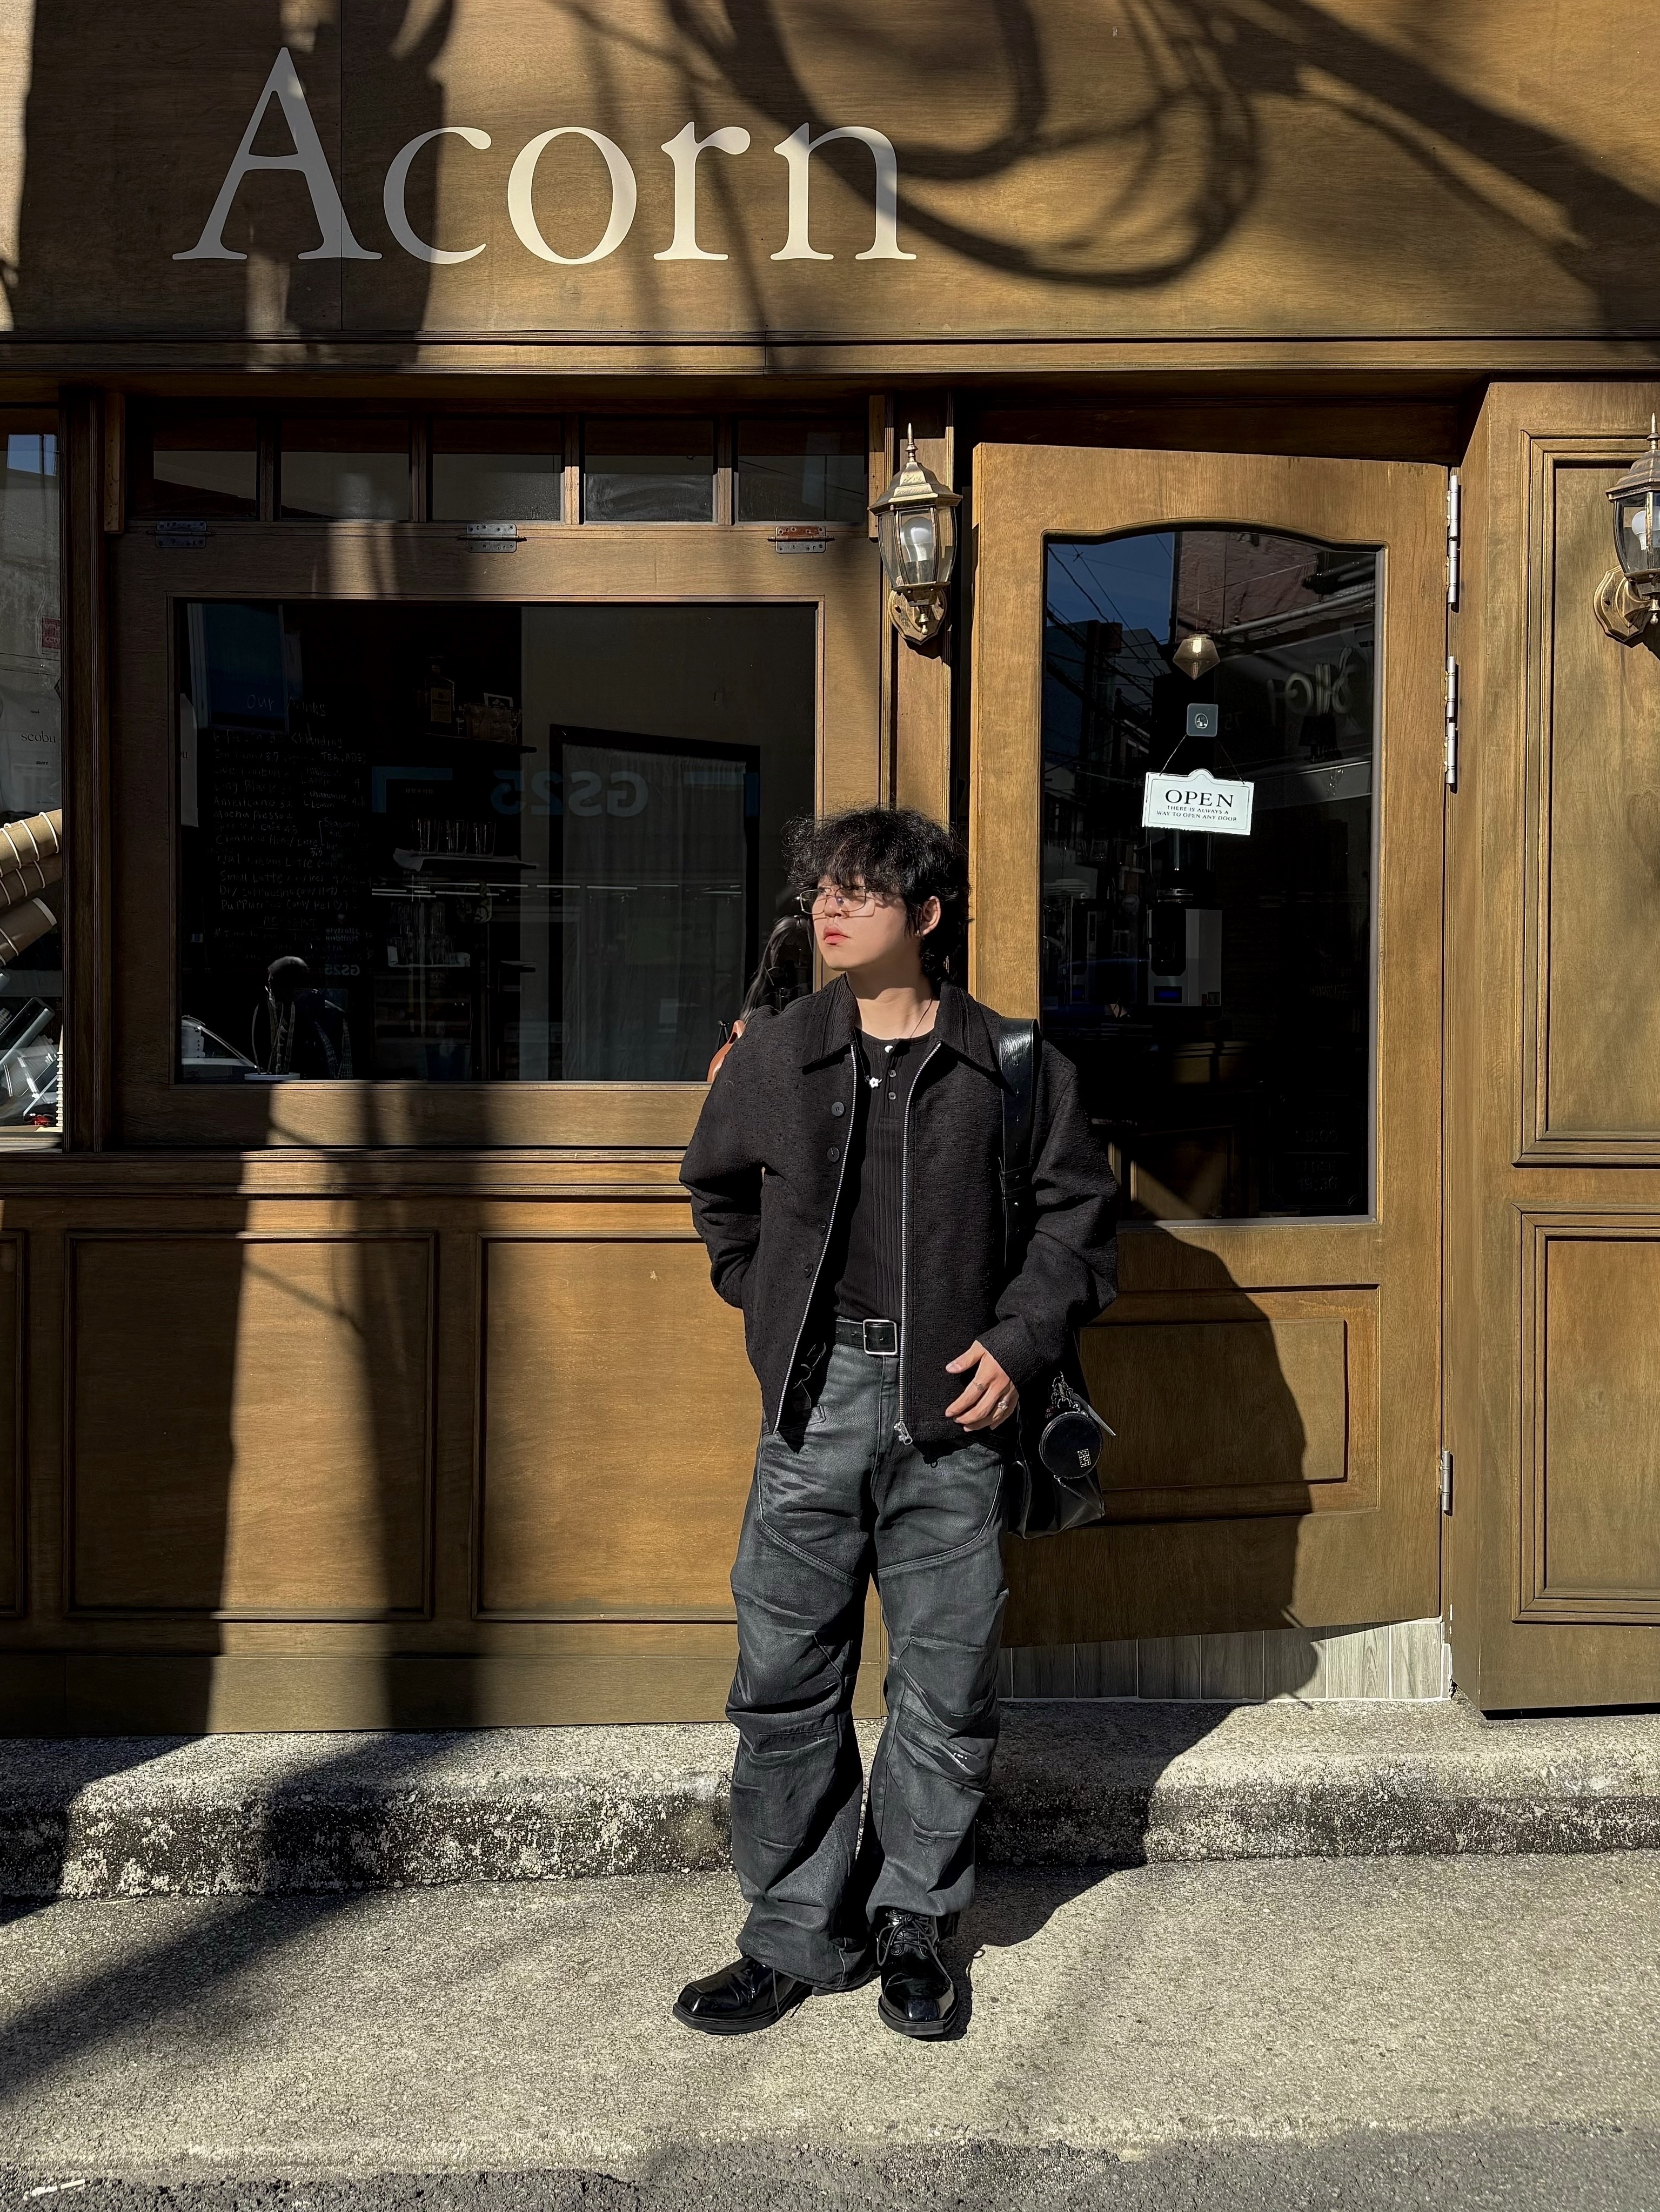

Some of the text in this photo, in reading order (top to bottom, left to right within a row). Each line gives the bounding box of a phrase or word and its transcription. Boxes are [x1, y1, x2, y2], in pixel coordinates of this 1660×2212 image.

[172, 47, 917, 265] Acorn
[247, 694, 274, 711] Our
[1165, 789, 1234, 808] OPEN
